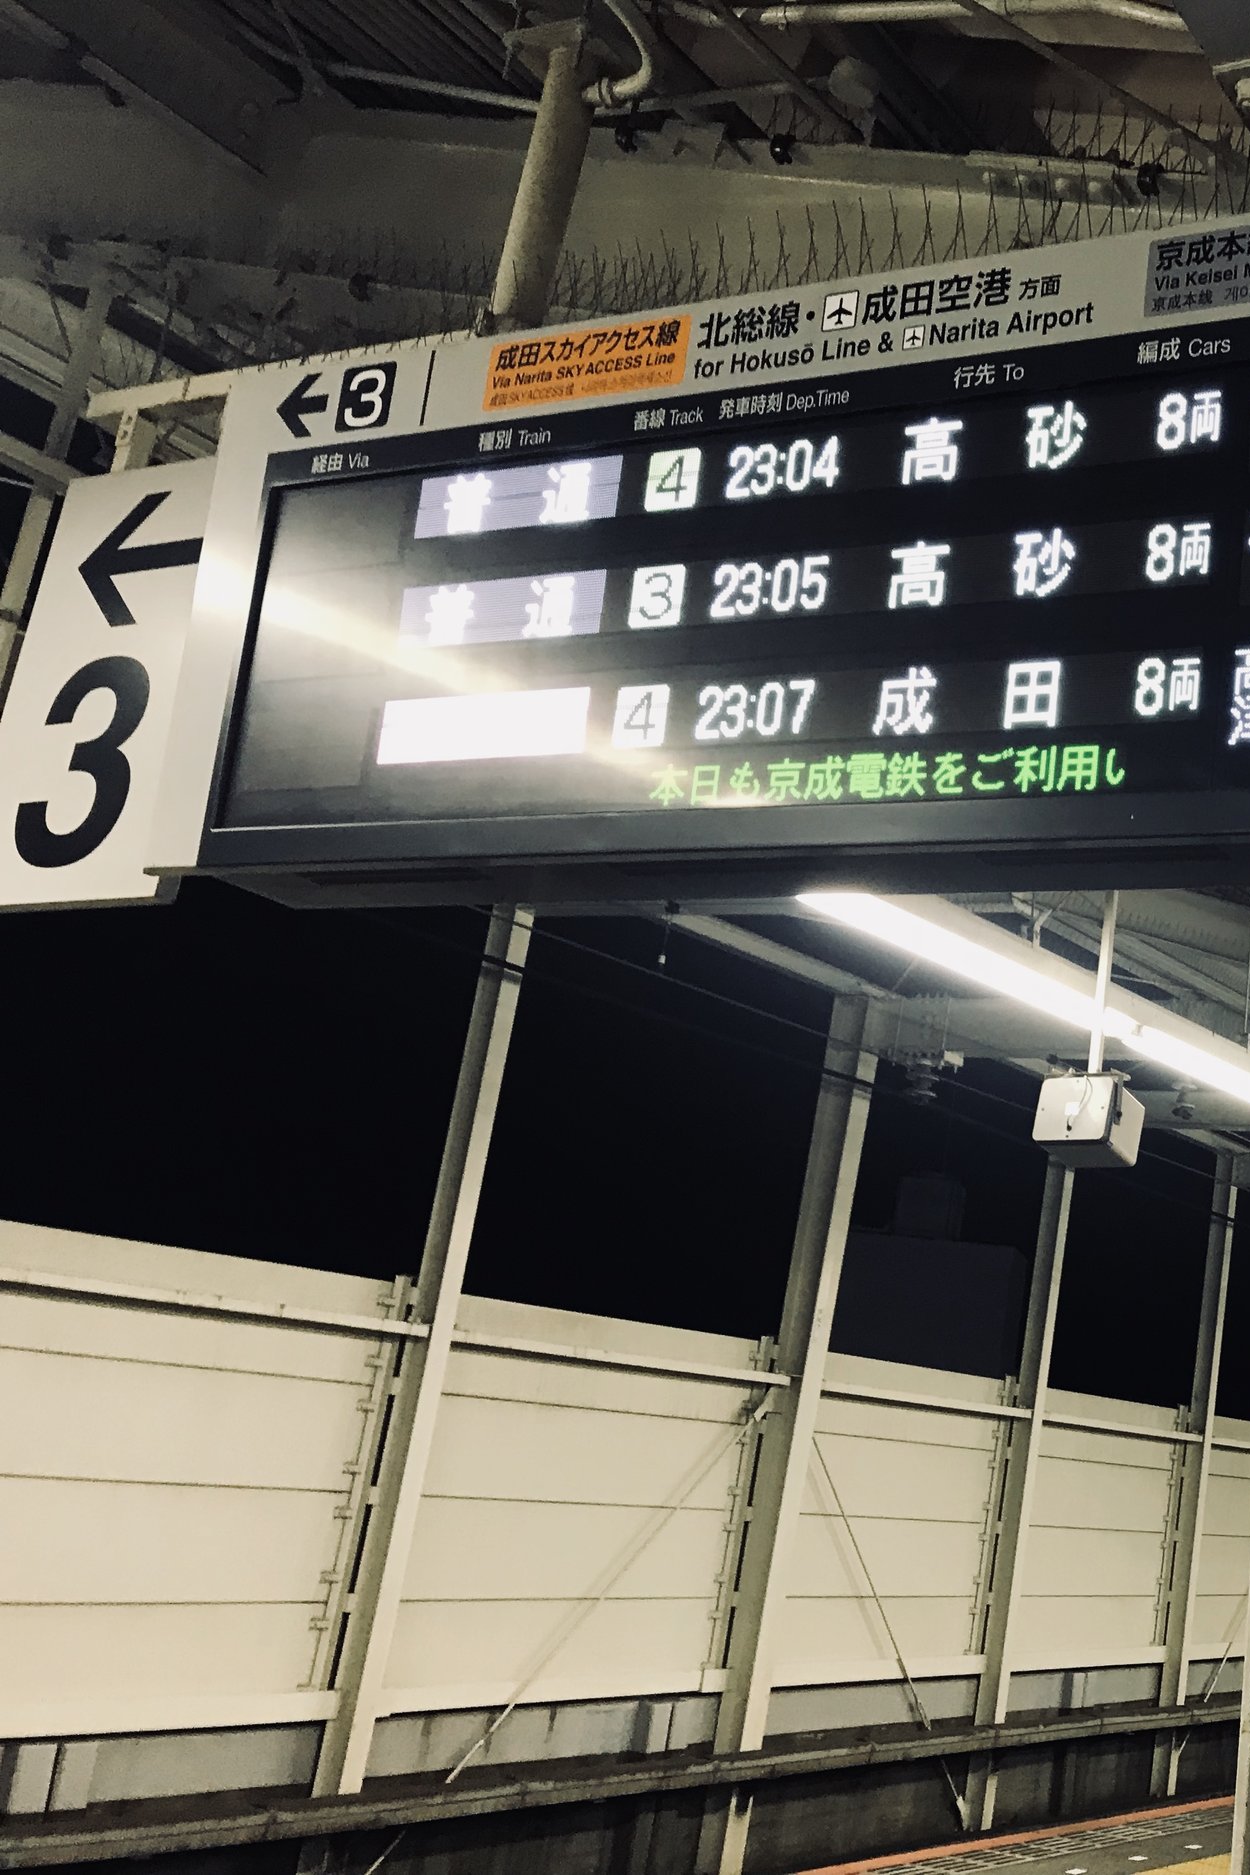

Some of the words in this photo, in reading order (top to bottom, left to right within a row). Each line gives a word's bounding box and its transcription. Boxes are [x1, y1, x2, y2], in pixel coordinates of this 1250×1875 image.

[862, 267, 1012, 325] 成田空港
[1019, 274, 1062, 301] 方面
[1155, 276, 1180, 291] Via
[1186, 265, 1238, 286] Keisei
[495, 320, 681, 371] 成田スカイアクセス線
[694, 358, 724, 379] for
[730, 342, 815, 374] Hokusō
[821, 338, 871, 360] Line
[877, 331, 894, 353] &
[929, 317, 1000, 345] Narita
[1006, 302, 1094, 336] Airport
[1136, 337, 1182, 364] 編成
[1188, 336, 1231, 358] Cars
[492, 375, 511, 389] Via
[515, 369, 552, 385] Narita
[646, 351, 675, 366] Line
[954, 363, 996, 389] 行先
[1002, 363, 1025, 382] To
[343, 368, 387, 428] 3
[633, 411, 665, 431] 番線
[670, 406, 704, 426] Track
[718, 391, 783, 420] 発車時刻
[1156, 390, 1223, 451] 8両
[347, 451, 369, 469] Via
[479, 430, 512, 452] 種別
[518, 428, 551, 447] Train
[900, 400, 1088, 485] 高砂
[311, 454, 342, 474] 経由
[725, 436, 841, 500] 23:04
[888, 528, 1076, 609] 高砂
[1146, 522, 1212, 582] 8両
[710, 556, 829, 619] 23:05
[695, 679, 816, 740] 23:07
[873, 659, 1061, 736] 成田
[1135, 657, 1201, 716] 8両
[14, 655, 151, 869] 3
